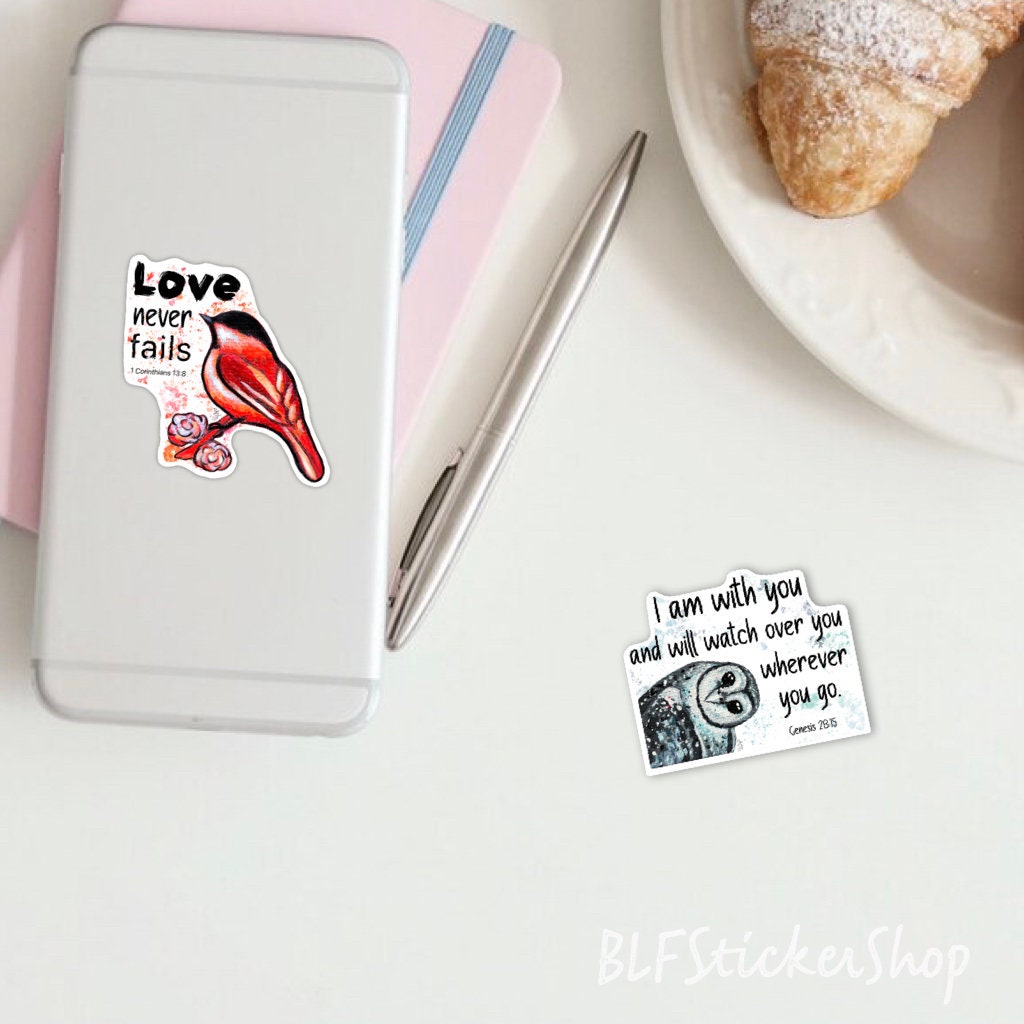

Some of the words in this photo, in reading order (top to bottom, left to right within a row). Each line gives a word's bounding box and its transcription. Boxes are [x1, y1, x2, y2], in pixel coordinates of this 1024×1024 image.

[134, 261, 241, 302] Love
[133, 307, 192, 328] never
[130, 333, 192, 362] fails
[135, 367, 171, 376] Corinthians
[653, 597, 661, 623] I
[668, 596, 703, 620] am
[711, 576, 757, 612] with
[764, 576, 803, 615] you
[629, 635, 662, 665] and
[668, 629, 699, 658] will
[703, 618, 759, 651] watch
[765, 617, 804, 640] over
[811, 610, 843, 642] you
[760, 647, 848, 679] wherever
[779, 687, 811, 719] you
[817, 682, 842, 710] go.
[789, 723, 817, 736] Genesis
